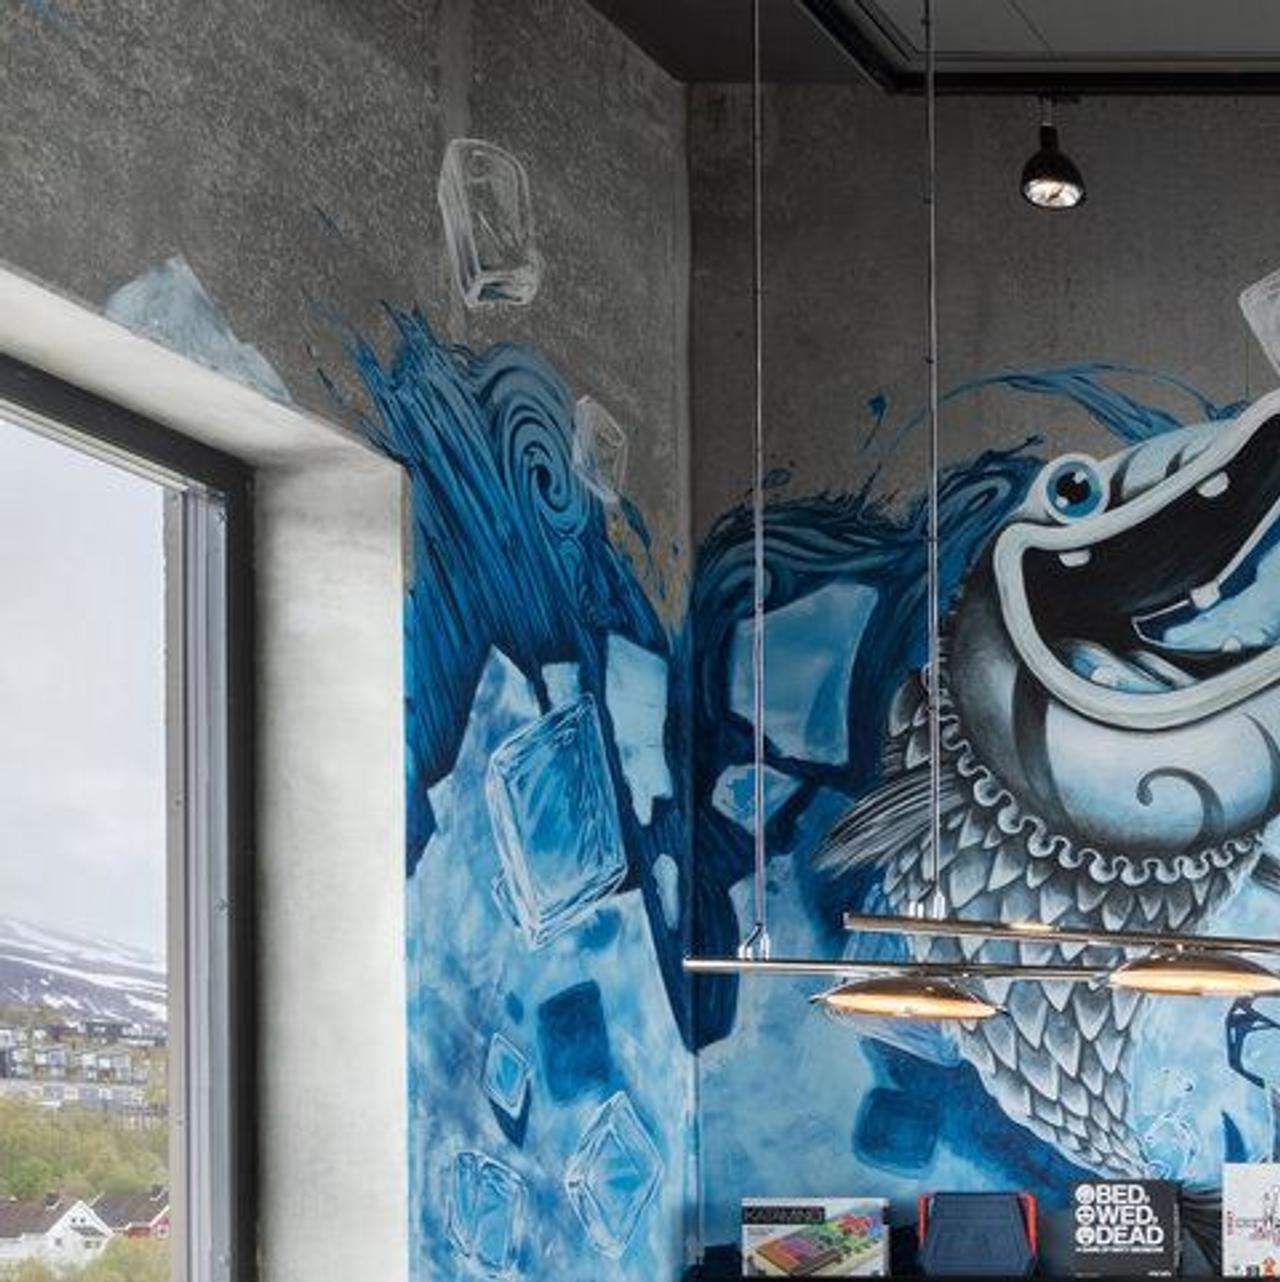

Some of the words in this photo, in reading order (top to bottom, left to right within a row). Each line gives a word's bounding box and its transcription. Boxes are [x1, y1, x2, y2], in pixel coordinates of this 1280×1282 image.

[1095, 1184, 1151, 1205] BED,
[1095, 1204, 1159, 1226] WED,
[1095, 1225, 1164, 1245] DEAD
